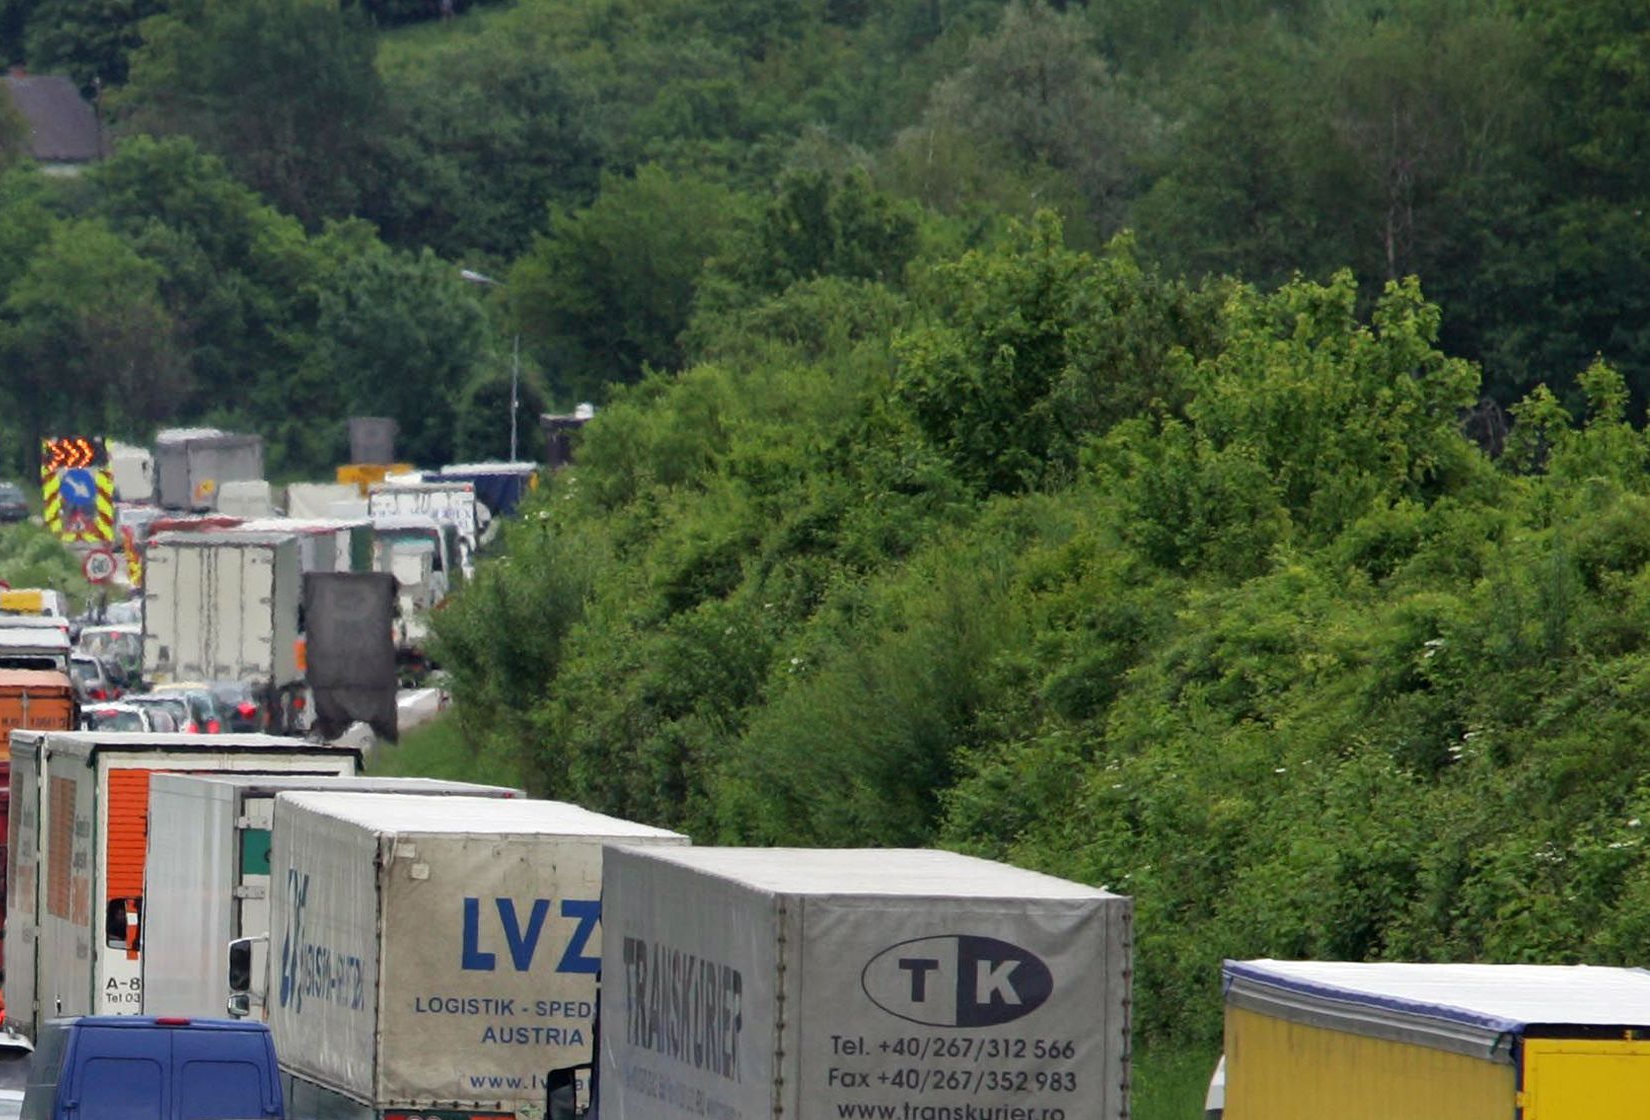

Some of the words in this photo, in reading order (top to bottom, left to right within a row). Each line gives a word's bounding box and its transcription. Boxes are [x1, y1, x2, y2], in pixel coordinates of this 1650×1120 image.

[461, 897, 601, 974] LVZ
[105, 993, 123, 1004] Tel
[415, 996, 515, 1016] LOGISTIK
[481, 1026, 585, 1047] AUSTRIA
[830, 1035, 870, 1056] Tel.
[878, 1036, 1027, 1063] +40/267/312
[1034, 1039, 1076, 1060] 566
[828, 1067, 871, 1089] Fax
[877, 1069, 1028, 1095] +40/267/352
[1035, 1071, 1077, 1093] 983
